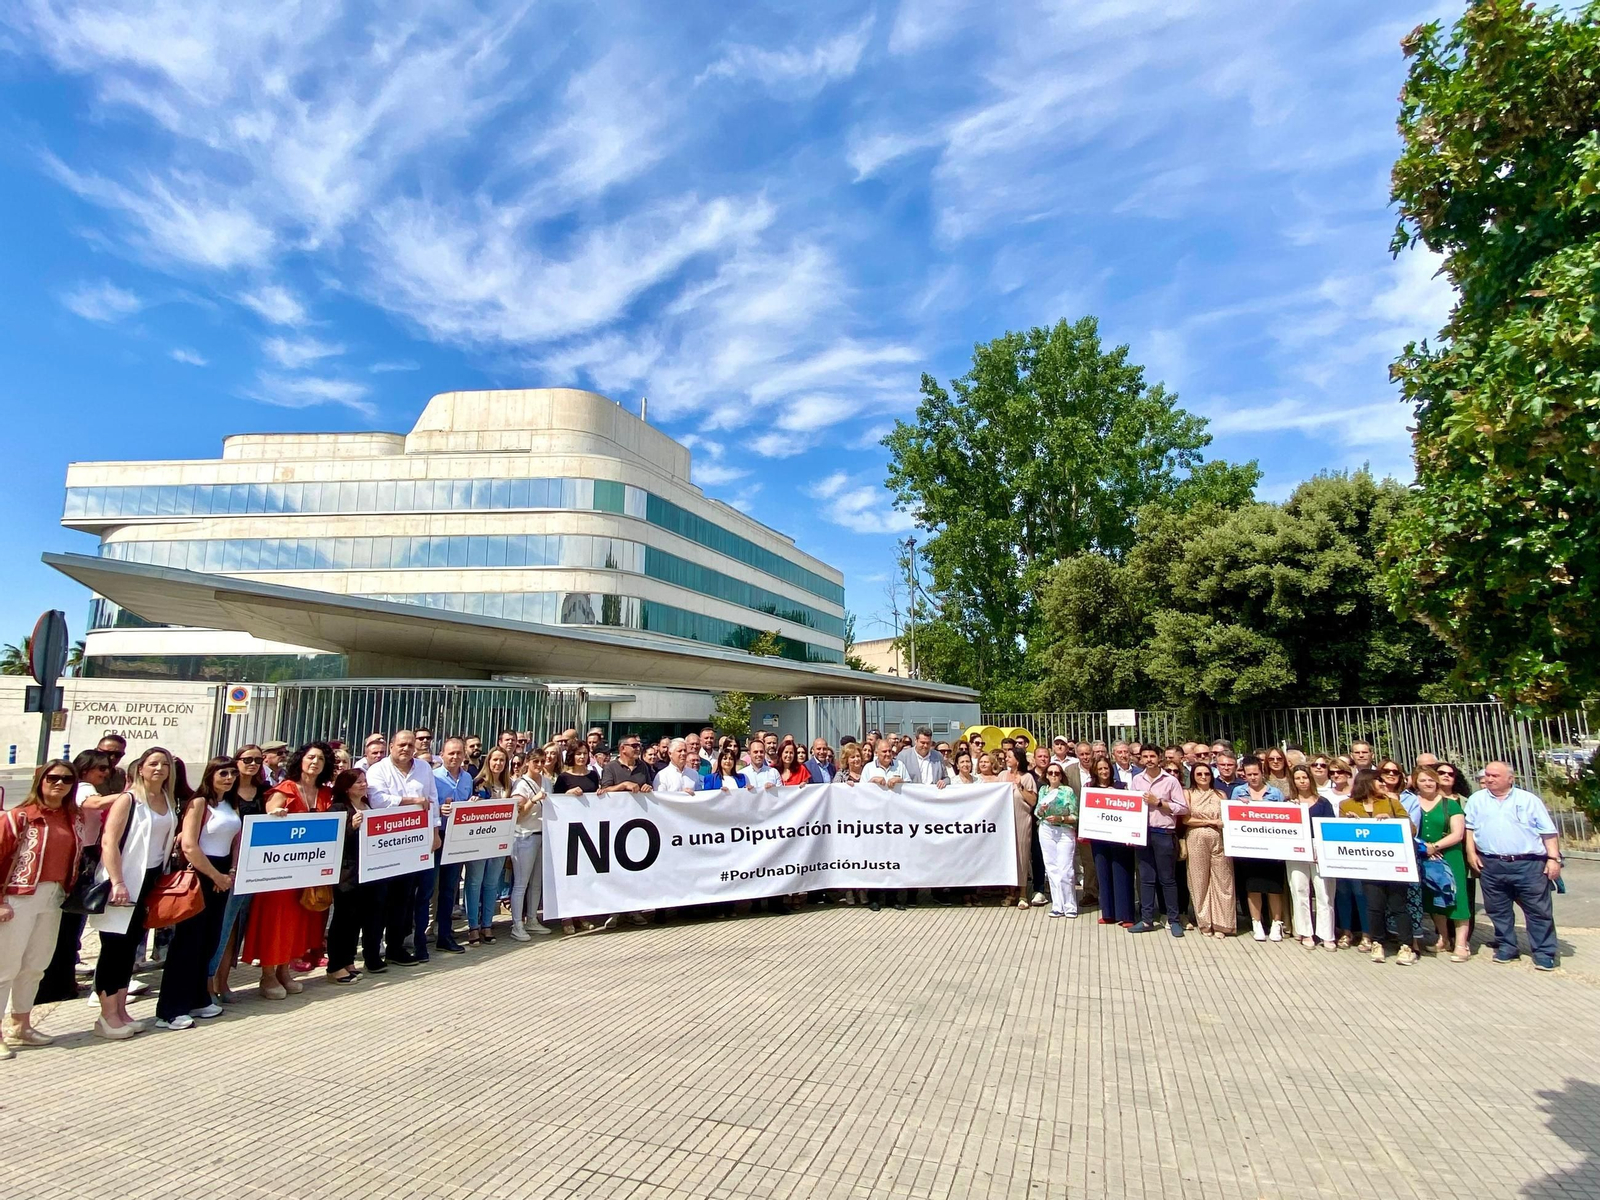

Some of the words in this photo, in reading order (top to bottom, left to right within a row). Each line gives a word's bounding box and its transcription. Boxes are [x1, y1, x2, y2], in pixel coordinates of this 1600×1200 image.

[125, 702, 194, 714] DIPUTACIÓN
[87, 715, 157, 726] PROVINCIAL
[163, 717, 178, 726] DE
[1104, 797, 1136, 810] Trabajo
[461, 811, 513, 822] Subvenciones
[1101, 812, 1122, 823] Fotos
[1248, 810, 1290, 820] Recursos
[383, 815, 421, 832] Igualdad
[290, 827, 307, 839] PP
[475, 825, 497, 835] dedo
[1240, 825, 1298, 835] Condiciones
[1355, 828, 1370, 839] PP
[377, 834, 424, 849] Sectarismo
[566, 818, 661, 876] NO
[671, 834, 683, 847] a
[689, 832, 725, 846] una
[730, 820, 832, 845] Diputación
[837, 819, 904, 838] injusta
[908, 823, 920, 839] y
[924, 819, 997, 835] sectaria
[262, 851, 281, 864] No
[283, 847, 326, 863] cumple
[1337, 846, 1395, 858] Mentiroso
[720, 859, 901, 882] #PorUnaDiputaciónJusta
